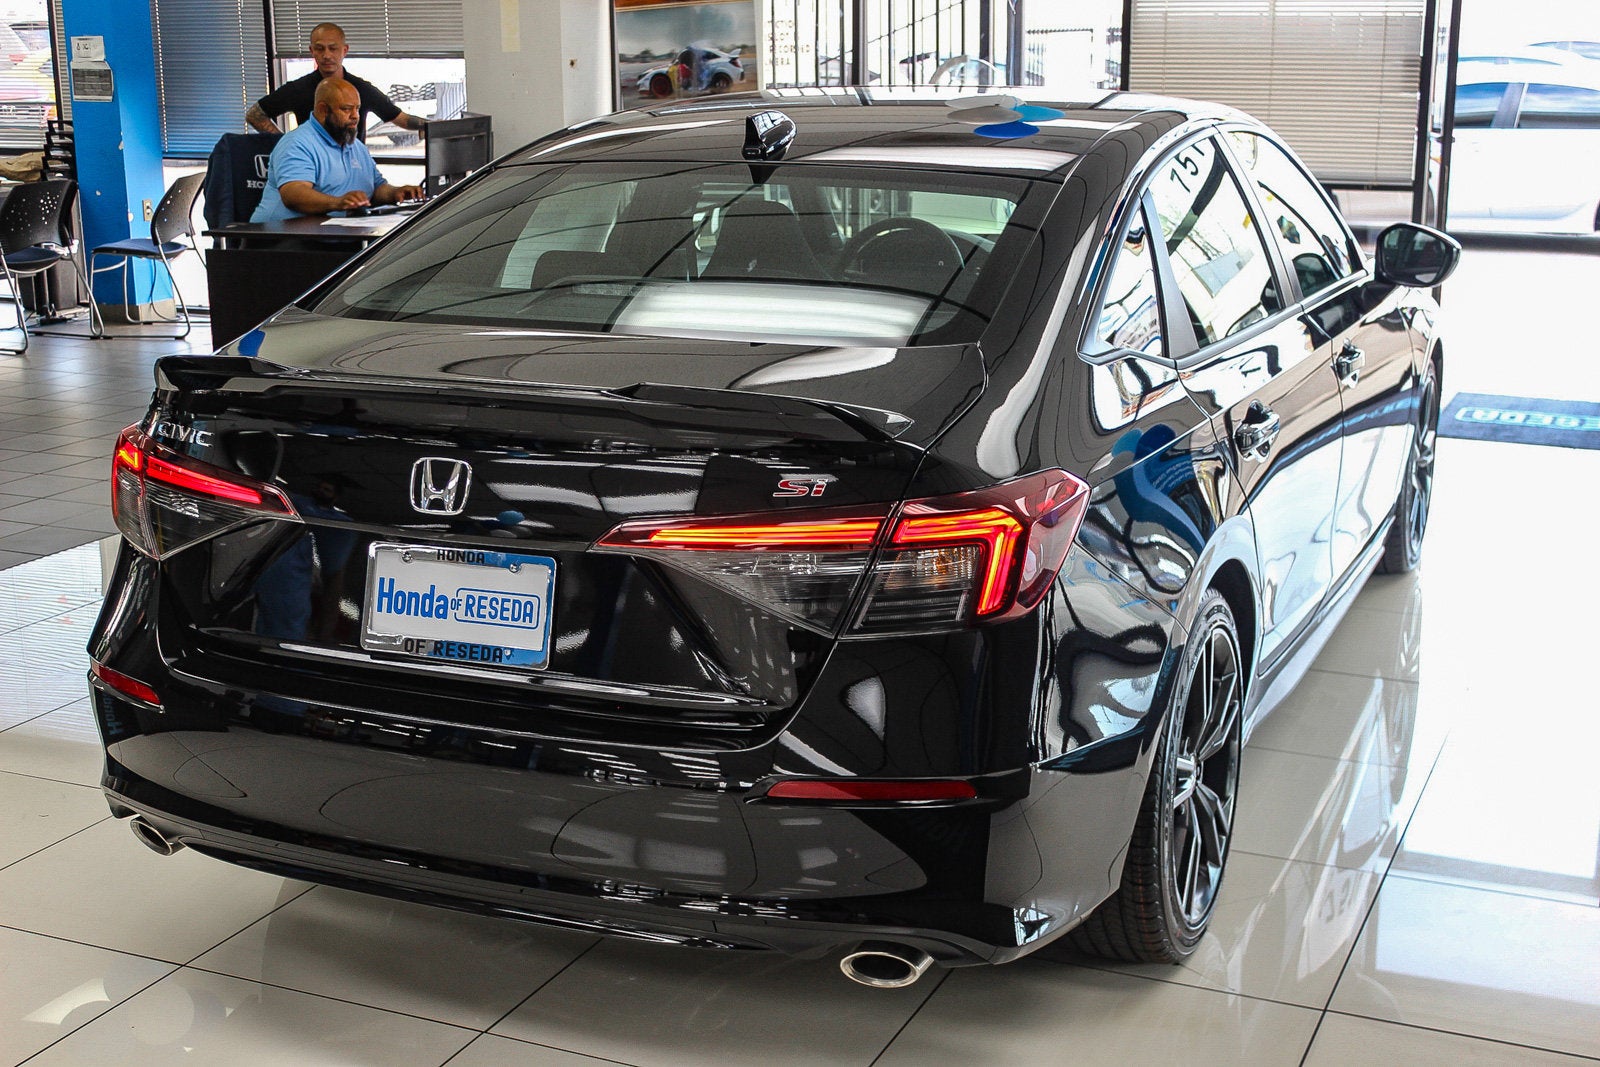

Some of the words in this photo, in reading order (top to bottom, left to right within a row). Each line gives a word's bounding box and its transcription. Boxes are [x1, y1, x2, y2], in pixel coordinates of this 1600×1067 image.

[246, 179, 266, 189] HO
[158, 420, 214, 447] CIVIC
[436, 549, 485, 564] HONDA
[377, 576, 449, 620] Honda
[450, 598, 462, 611] OF
[464, 594, 534, 624] RESEDA
[404, 637, 426, 653] OF
[433, 640, 503, 663] RESEDA
